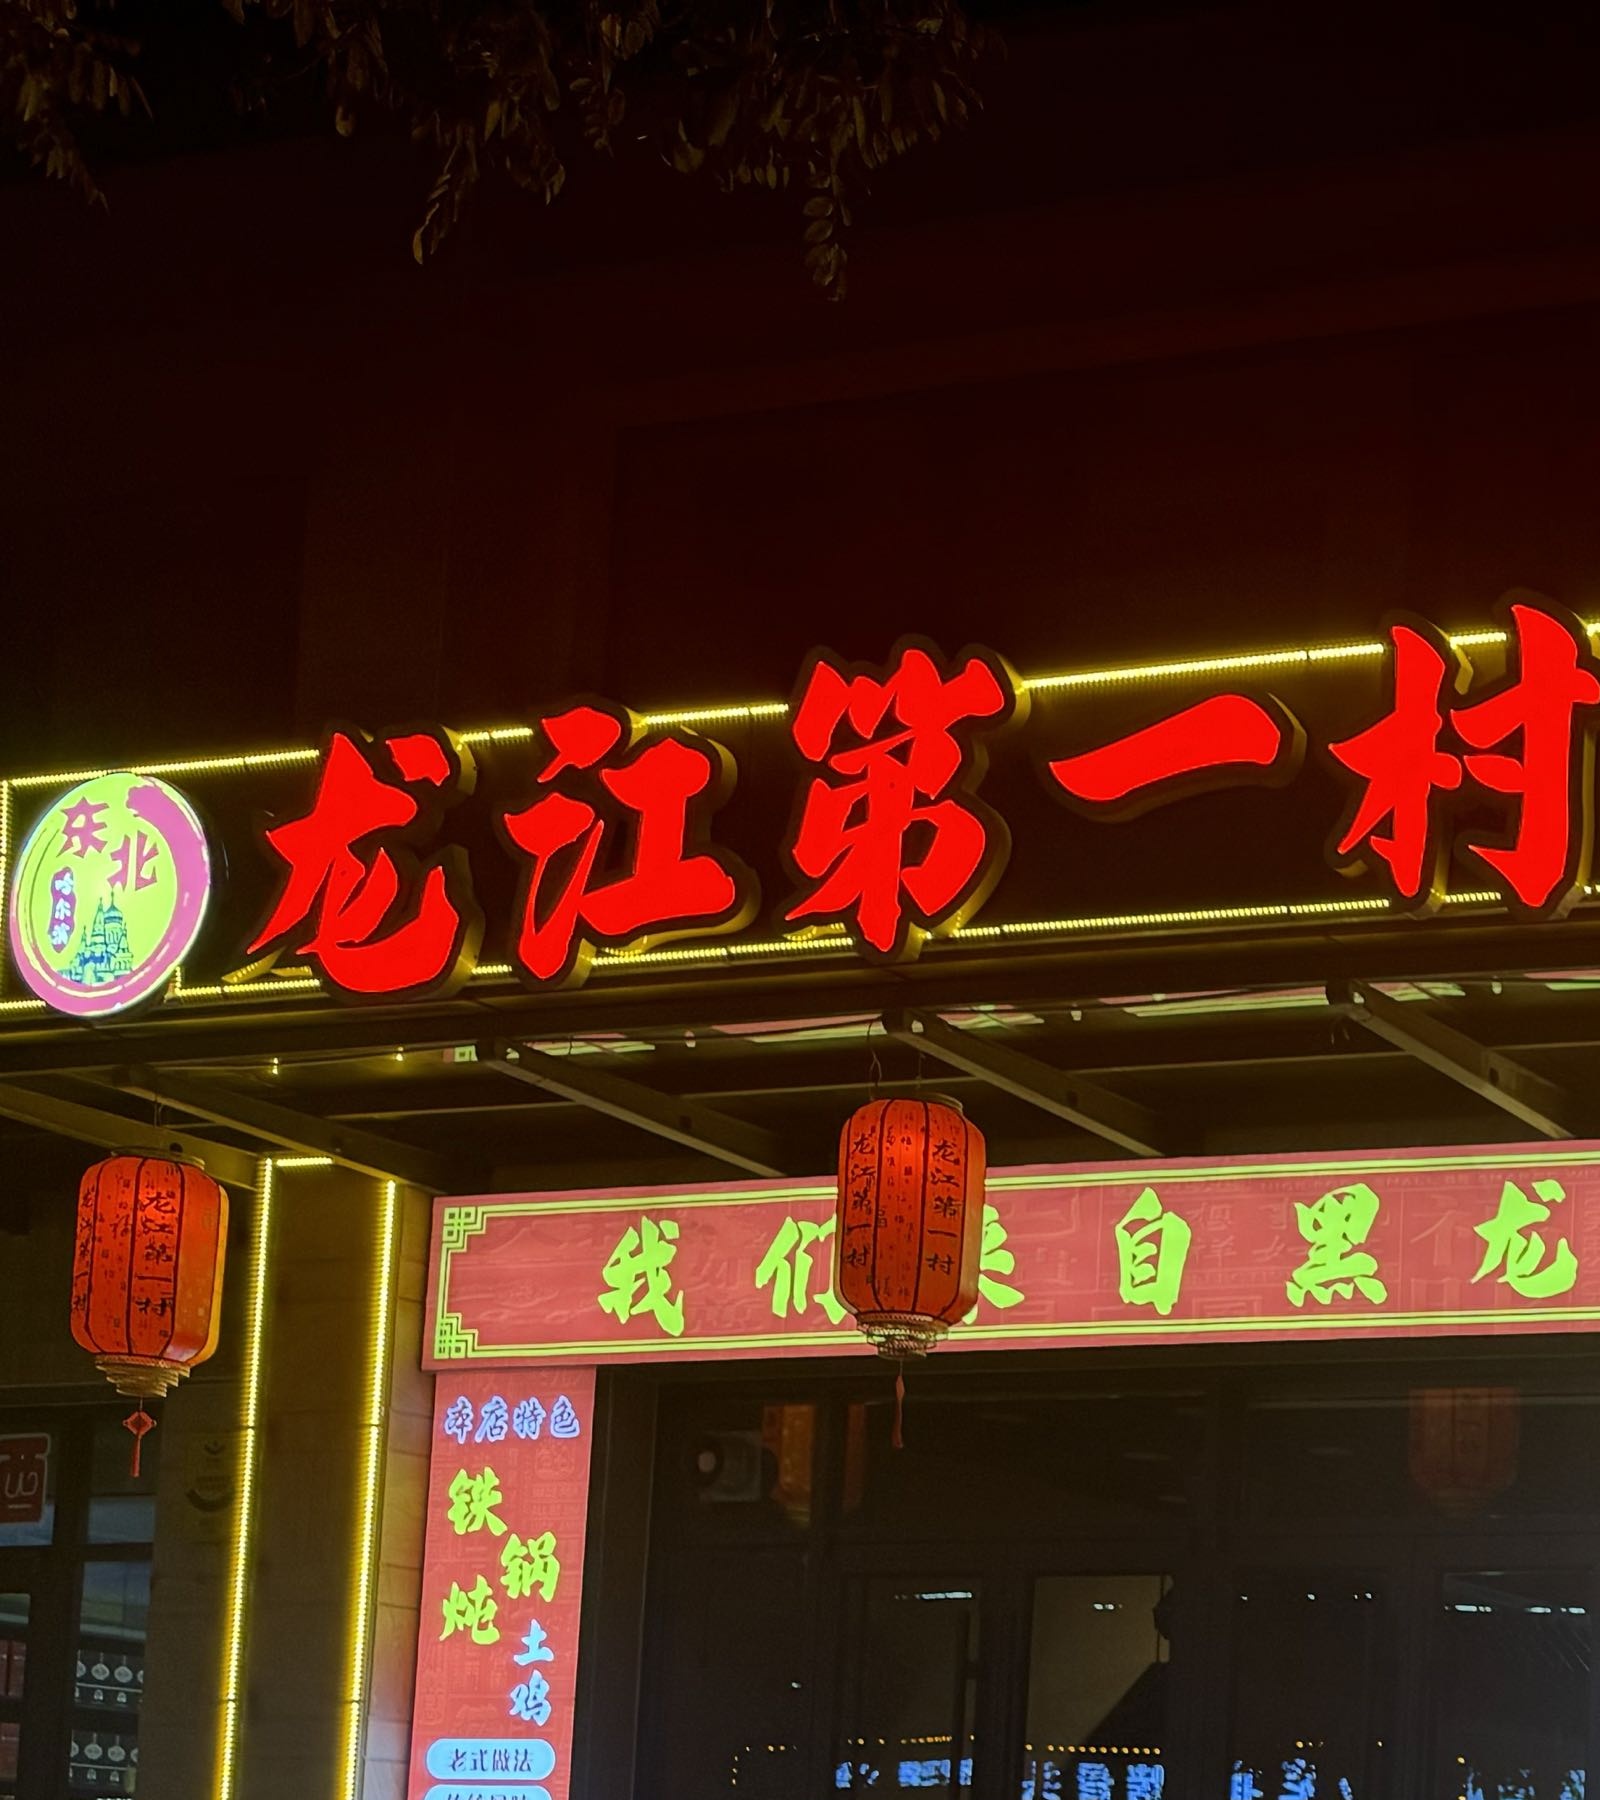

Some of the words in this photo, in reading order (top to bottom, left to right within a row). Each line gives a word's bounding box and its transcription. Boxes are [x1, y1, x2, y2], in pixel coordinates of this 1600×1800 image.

[56, 796, 160, 892] 东北
[134, 1190, 176, 1318] 龙江第一村
[845, 1125, 876, 1268] 龙江第一村
[926, 1137, 961, 1276] 龙江第一村
[444, 1395, 581, 1445] 本店特色
[439, 1466, 561, 1646] 铁锅炖
[508, 1618, 555, 1727] 土鸡
[448, 1747, 535, 1773] 老式做法
